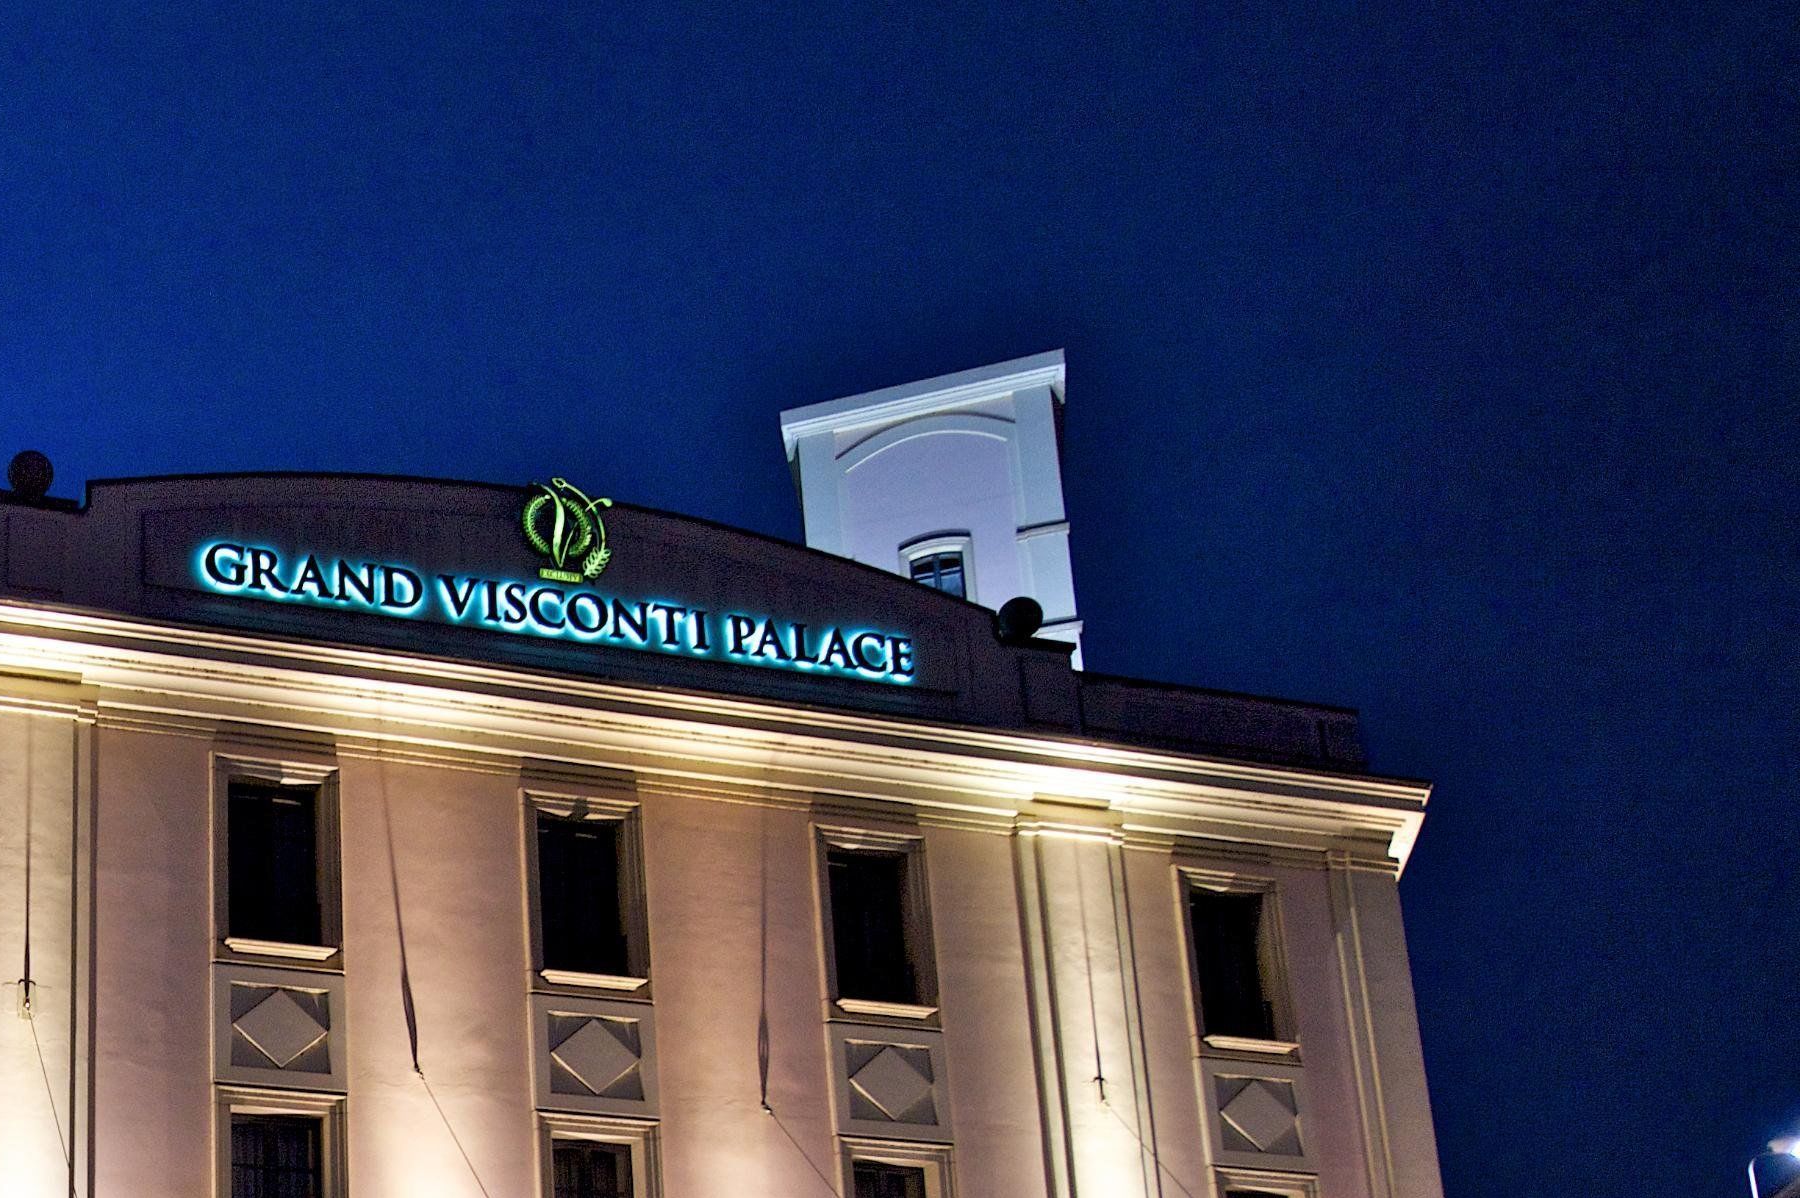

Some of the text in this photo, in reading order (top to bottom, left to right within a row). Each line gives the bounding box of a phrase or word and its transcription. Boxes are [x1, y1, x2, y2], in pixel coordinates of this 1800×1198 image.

[204, 542, 915, 677] GRAND VISCONTI PALACE
